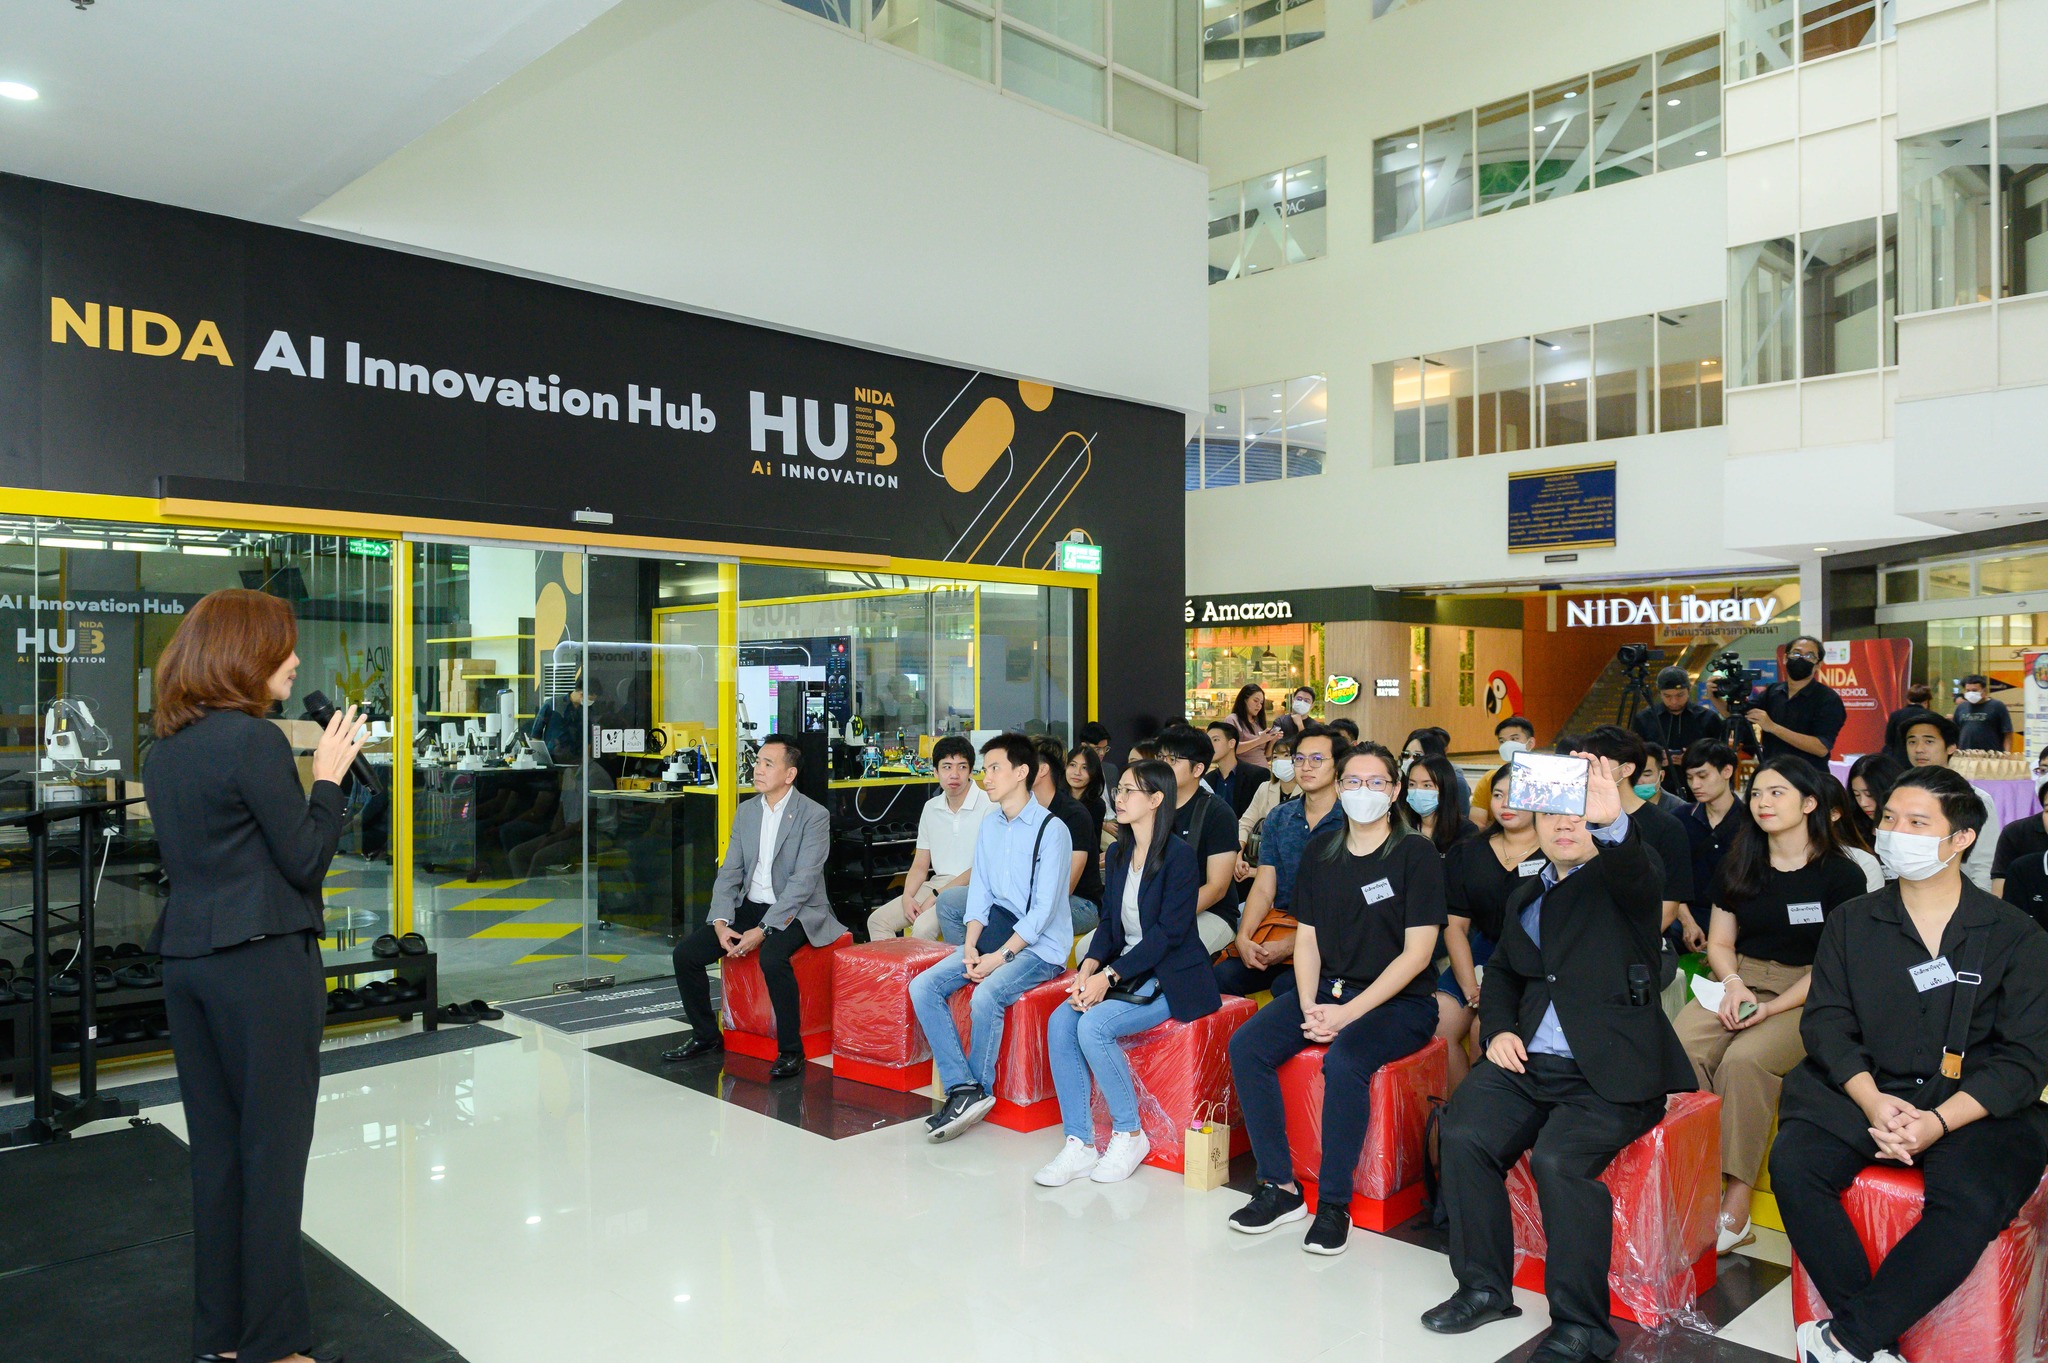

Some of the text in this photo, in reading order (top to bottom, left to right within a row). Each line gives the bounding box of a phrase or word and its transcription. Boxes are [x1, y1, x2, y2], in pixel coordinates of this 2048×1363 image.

[51, 297, 717, 434] NIDA AI Innovation Hub
[855, 386, 895, 408] NIDA
[750, 390, 898, 467] HUB
[751, 460, 898, 489] Ai INNOVATION
[0, 594, 185, 614] AI Innovation Hub
[1201, 600, 1292, 622] Amazon
[1566, 594, 1777, 628] NIDA Library
[79, 621, 104, 629] NIDA
[16, 627, 106, 655] HUB
[37, 656, 106, 664] NNOVATION
[1818, 667, 1858, 687] NIDA
[1841, 688, 1868, 697] SCHOOL
